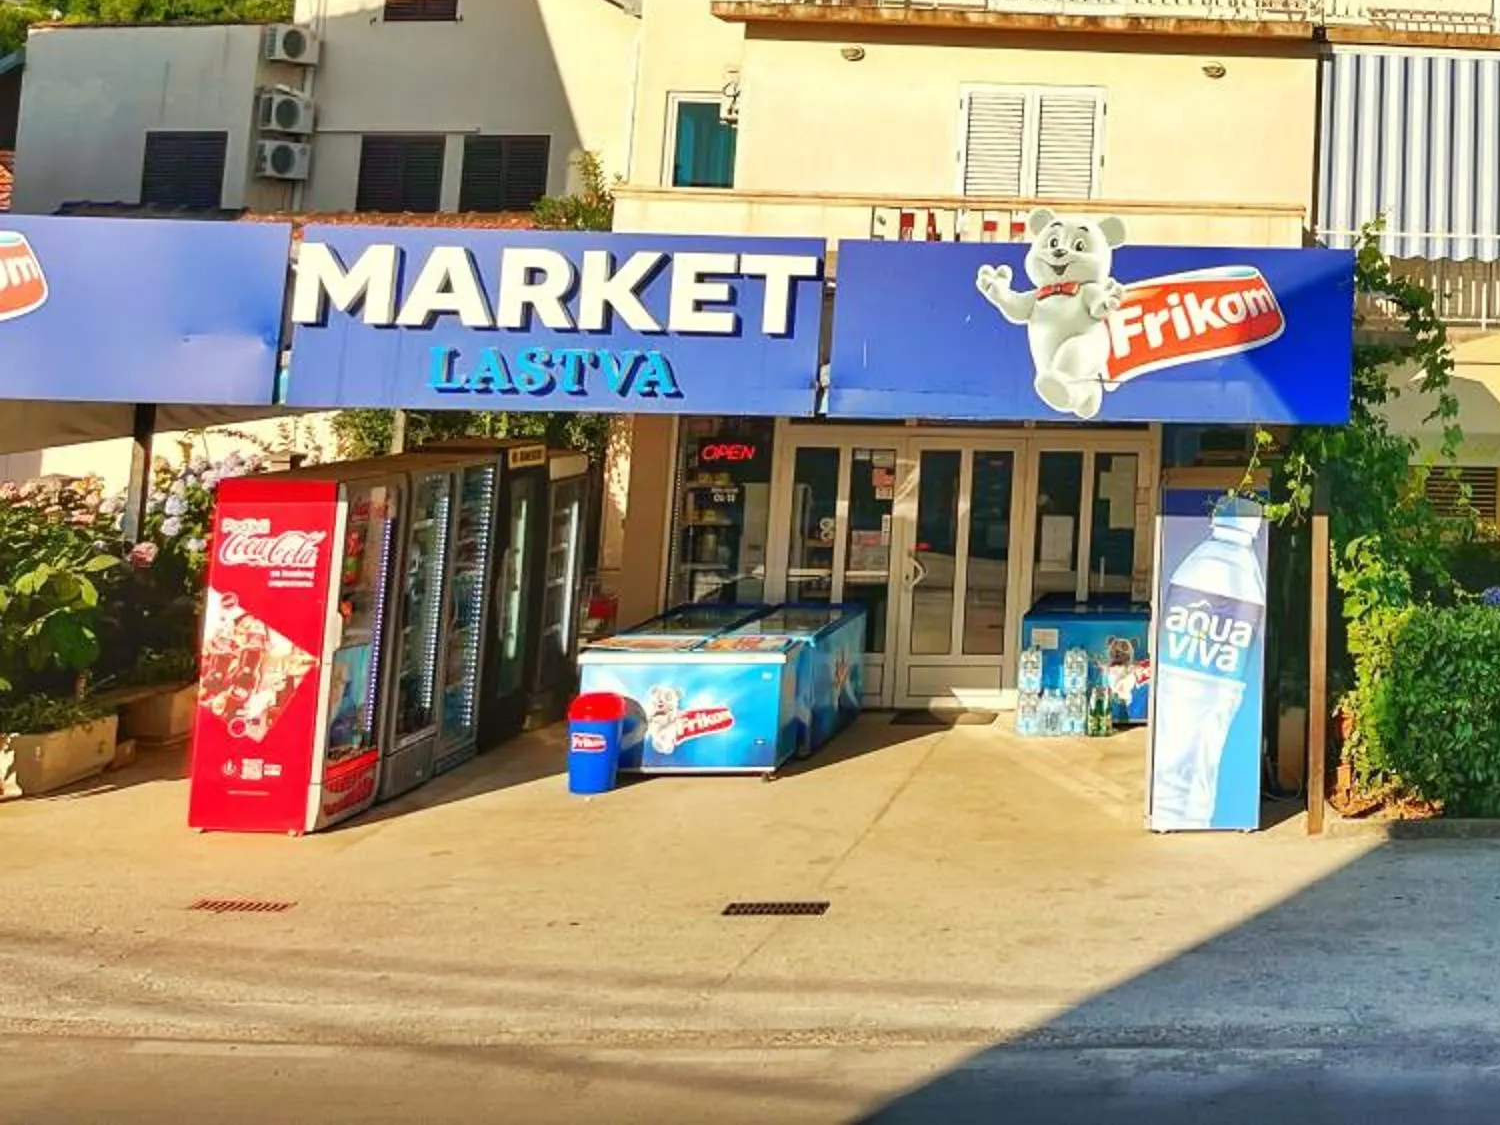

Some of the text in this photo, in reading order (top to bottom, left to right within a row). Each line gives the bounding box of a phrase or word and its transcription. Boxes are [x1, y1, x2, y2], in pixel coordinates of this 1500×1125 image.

[291, 242, 817, 334] MARKET
[1108, 287, 1274, 359] Frikom
[427, 346, 680, 394] LASTVA
[703, 443, 756, 460] OPEN
[1168, 632, 1239, 672] viva
